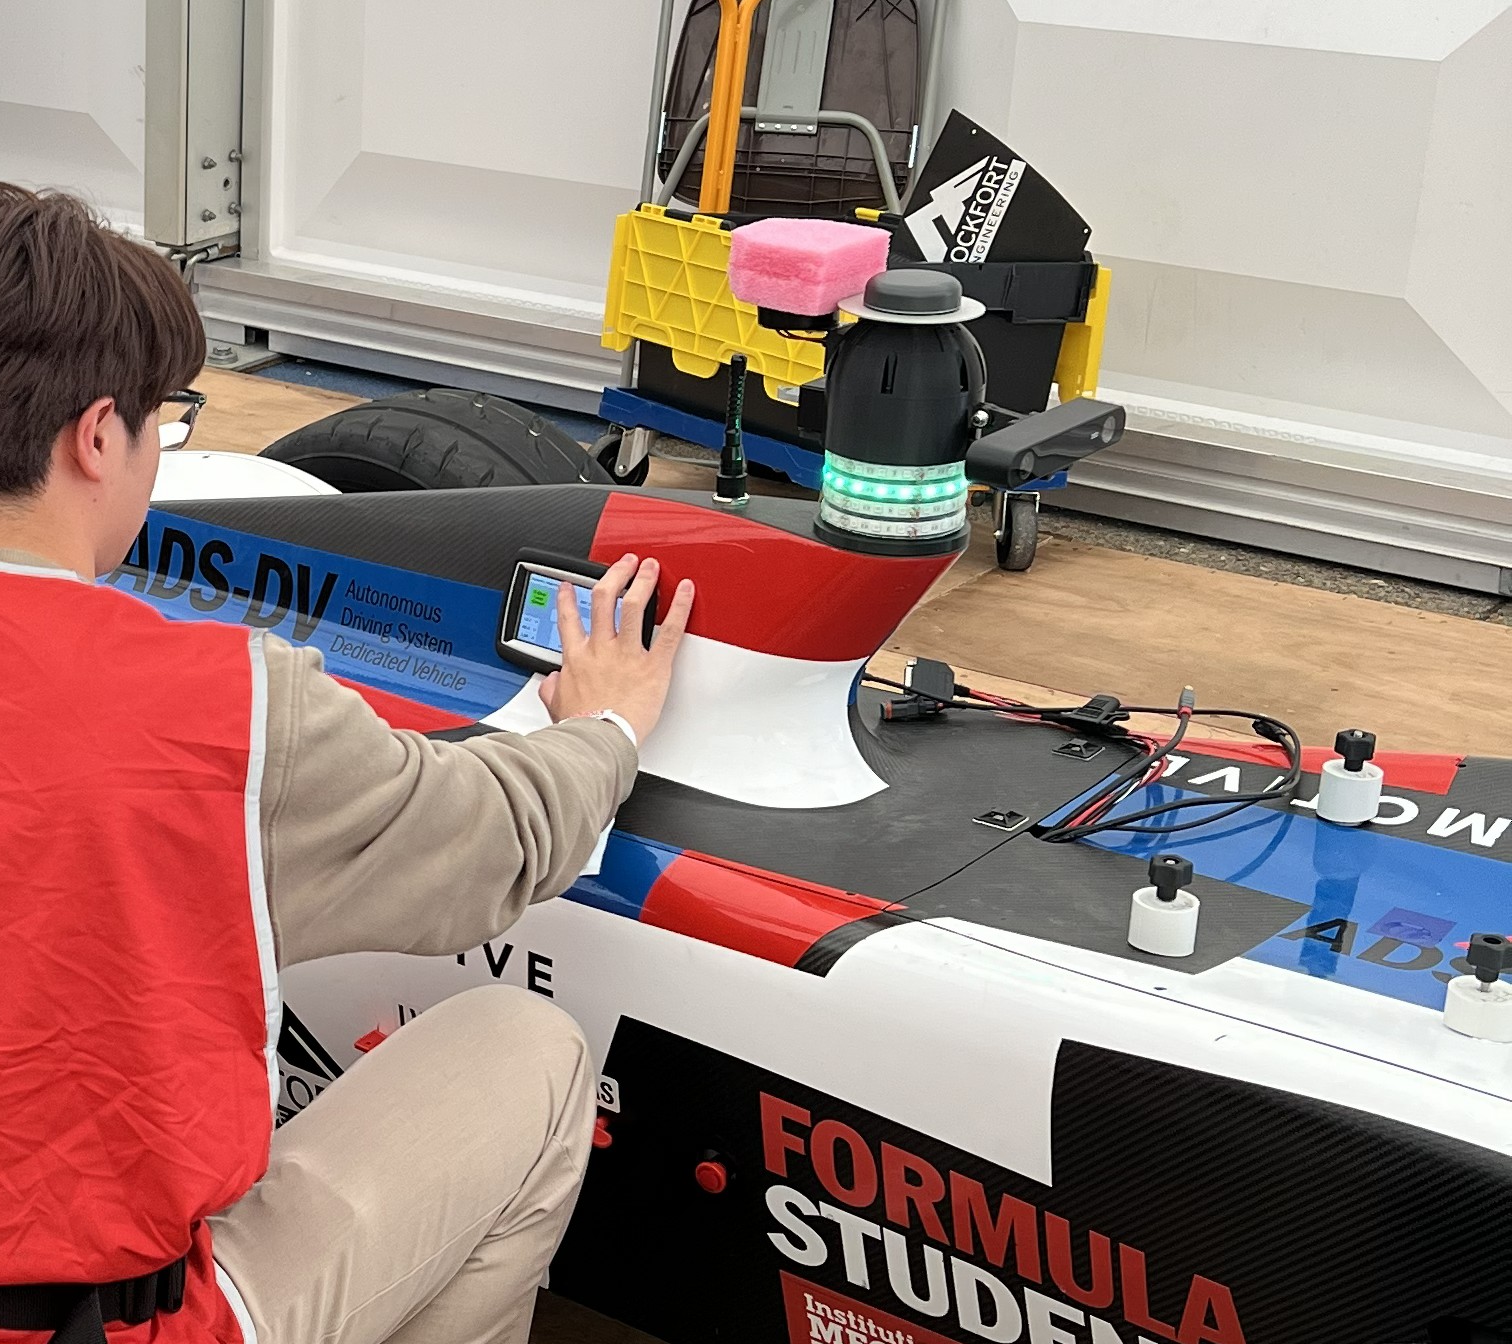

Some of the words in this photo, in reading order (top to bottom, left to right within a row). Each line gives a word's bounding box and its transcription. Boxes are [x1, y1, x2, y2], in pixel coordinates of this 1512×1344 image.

[950, 156, 1008, 263] OCKFORT
[972, 170, 1019, 263] NGINEERING
[344, 579, 442, 623] Autonomous
[341, 607, 393, 643] Driving
[396, 623, 453, 656] System
[330, 635, 411, 673] Dedicated
[411, 657, 467, 691] Vehicle
